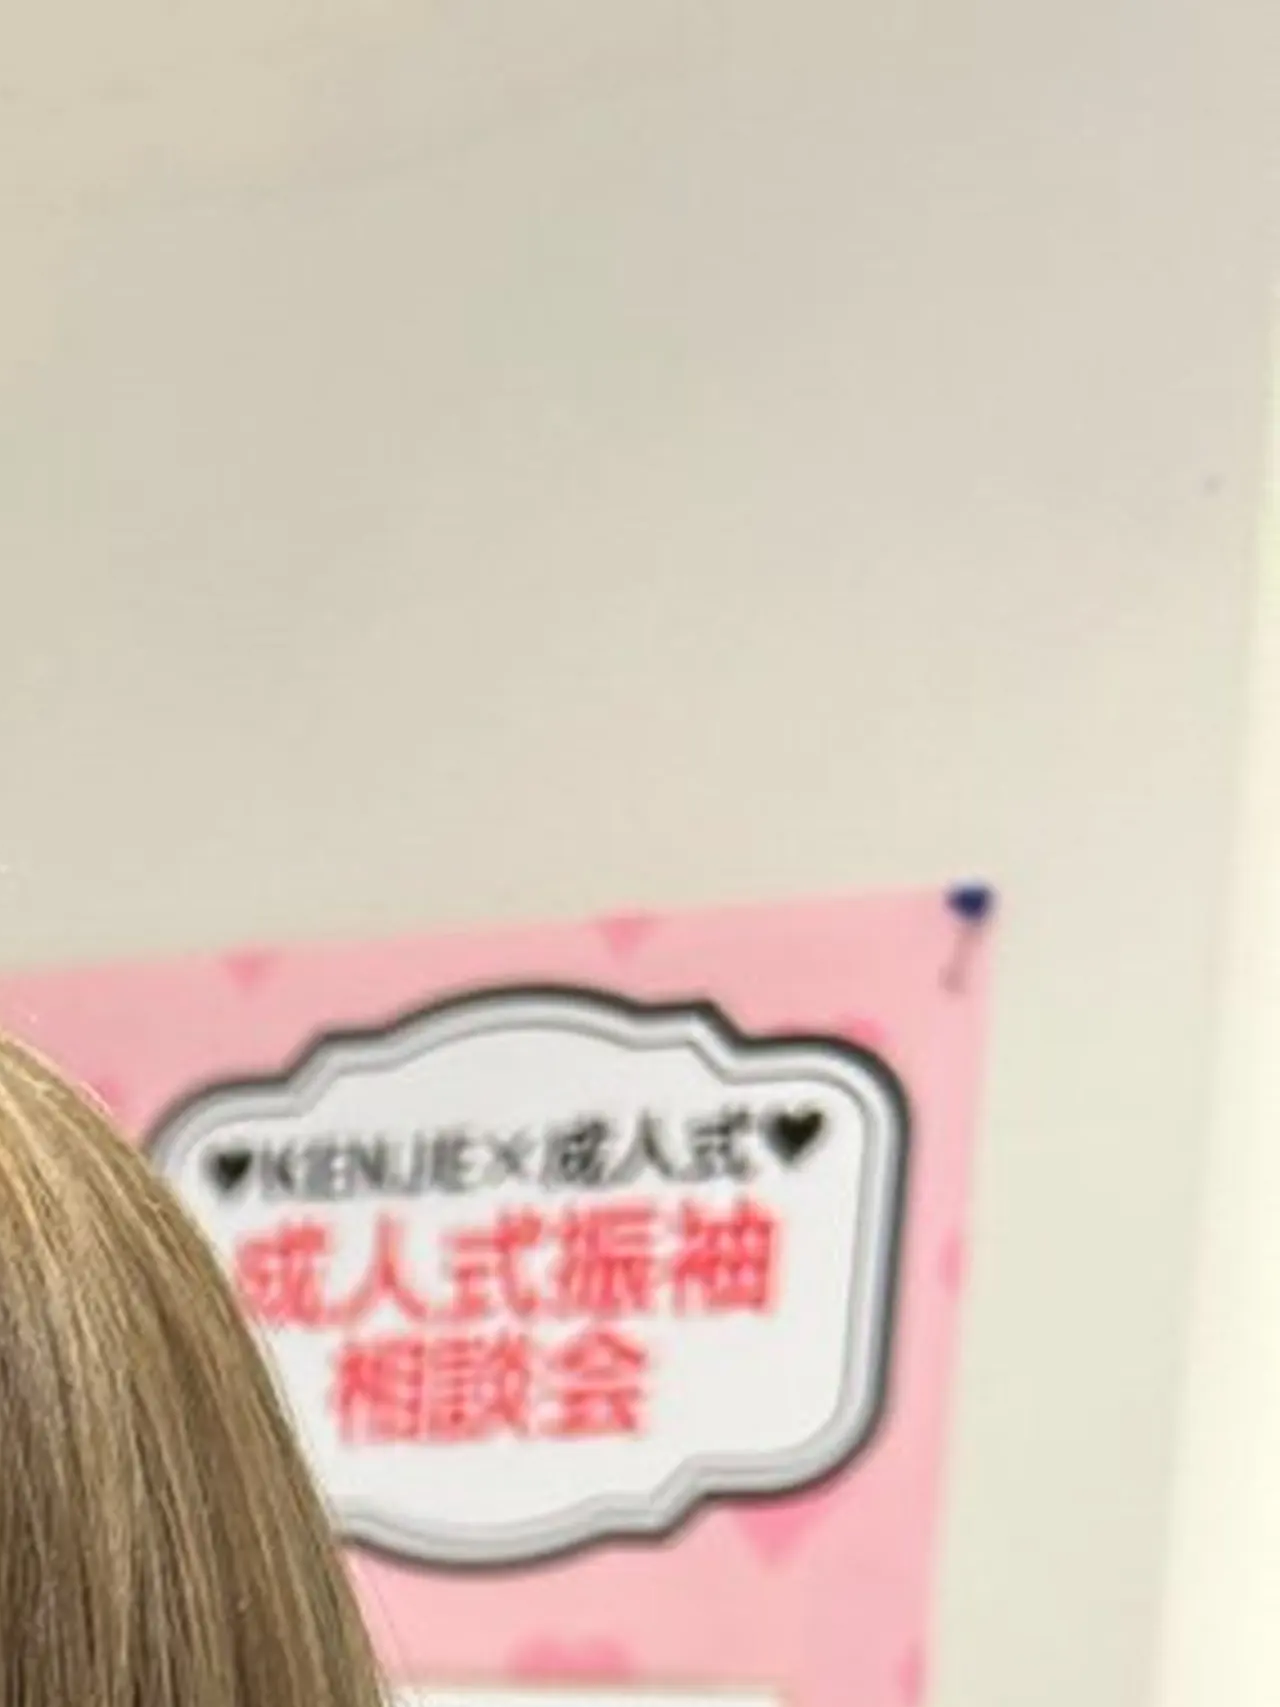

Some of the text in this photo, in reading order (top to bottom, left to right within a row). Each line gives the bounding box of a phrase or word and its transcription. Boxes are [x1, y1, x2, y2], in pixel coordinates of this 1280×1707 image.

[237, 1200, 780, 1326] 成人式振袖
[333, 1330, 647, 1443] 相談会
